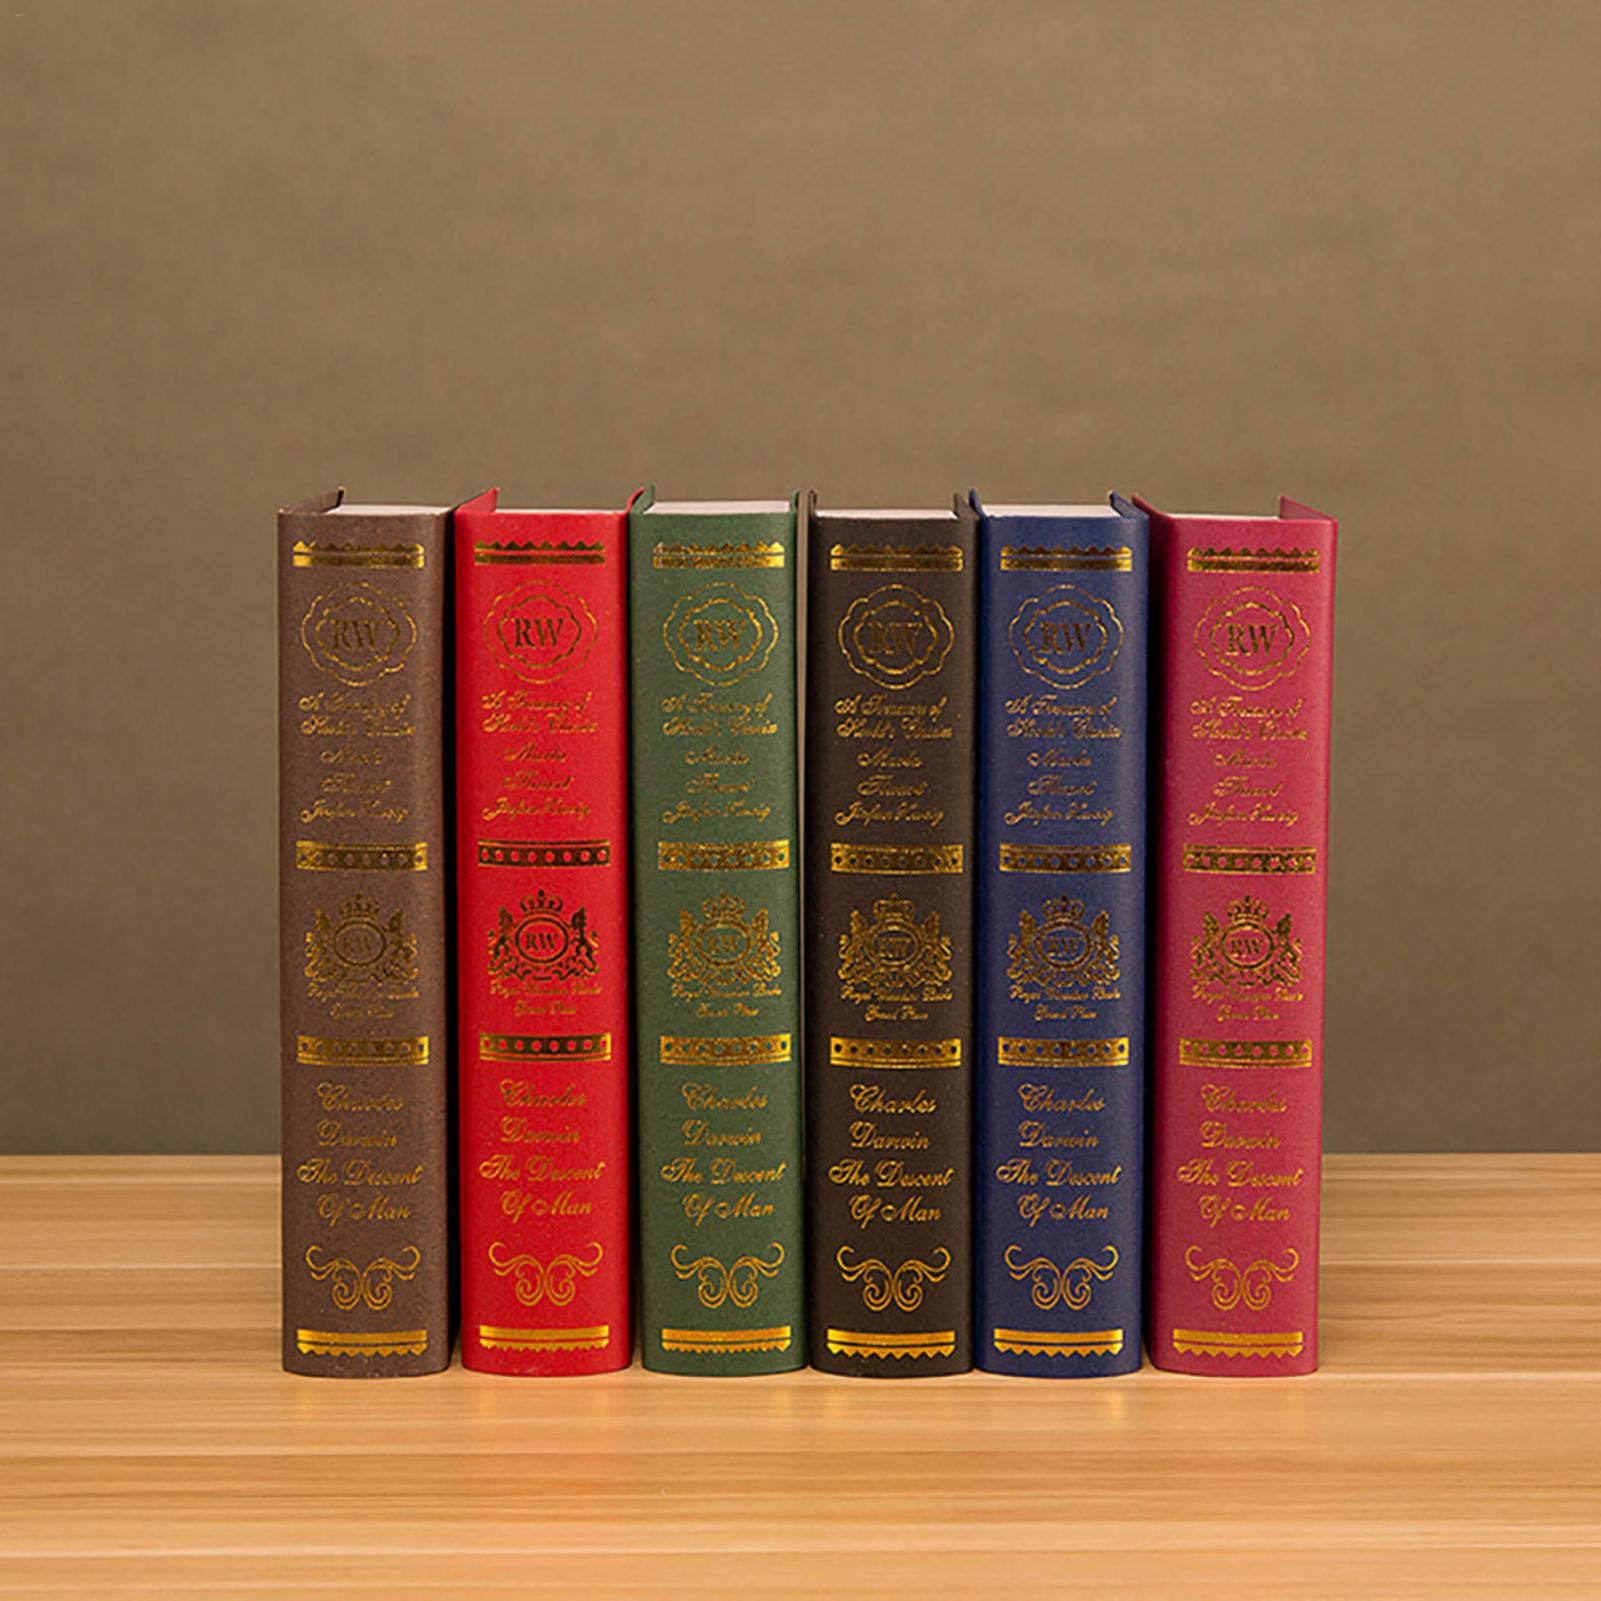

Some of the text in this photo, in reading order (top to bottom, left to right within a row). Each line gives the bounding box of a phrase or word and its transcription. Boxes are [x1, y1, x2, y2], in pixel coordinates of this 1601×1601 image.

[329, 618, 382, 649] RW
[512, 617, 564, 647] RW
[694, 618, 748, 649] RW
[867, 621, 923, 654] RW
[1039, 622, 1093, 655] RW
[1226, 623, 1281, 656] RW
[343, 934, 374, 951] RW
[525, 932, 559, 951] RW
[317, 1083, 403, 1111] Charles
[499, 1078, 586, 1106] Charles
[682, 1081, 768, 1109] Charles
[850, 1084, 936, 1112] Charles
[1019, 1083, 1105, 1111] Charles
[1201, 1084, 1287, 1112] Charles
[317, 1120, 397, 1147] Darwin
[499, 1115, 580, 1143] Darwin
[682, 1118, 762, 1145] Darwin
[850, 1121, 930, 1149] Darwin
[1018, 1120, 1098, 1147] Darwin
[1200, 1121, 1280, 1148] Darwin
[296, 1158, 422, 1185] The Descent
[479, 1154, 605, 1181] The Descent
[662, 1157, 787, 1184] The Descent
[829, 1159, 954, 1187] The Descent
[997, 1159, 1123, 1185] The Descent
[1178, 1159, 1304, 1187] The Descent
[317, 1193, 409, 1227] Of Man
[500, 1190, 592, 1224] Of Man
[683, 1192, 774, 1226] Of Man
[849, 1195, 940, 1228] Of Man
[1018, 1194, 1109, 1227] Of Man
[1198, 1194, 1290, 1228] Of Man
